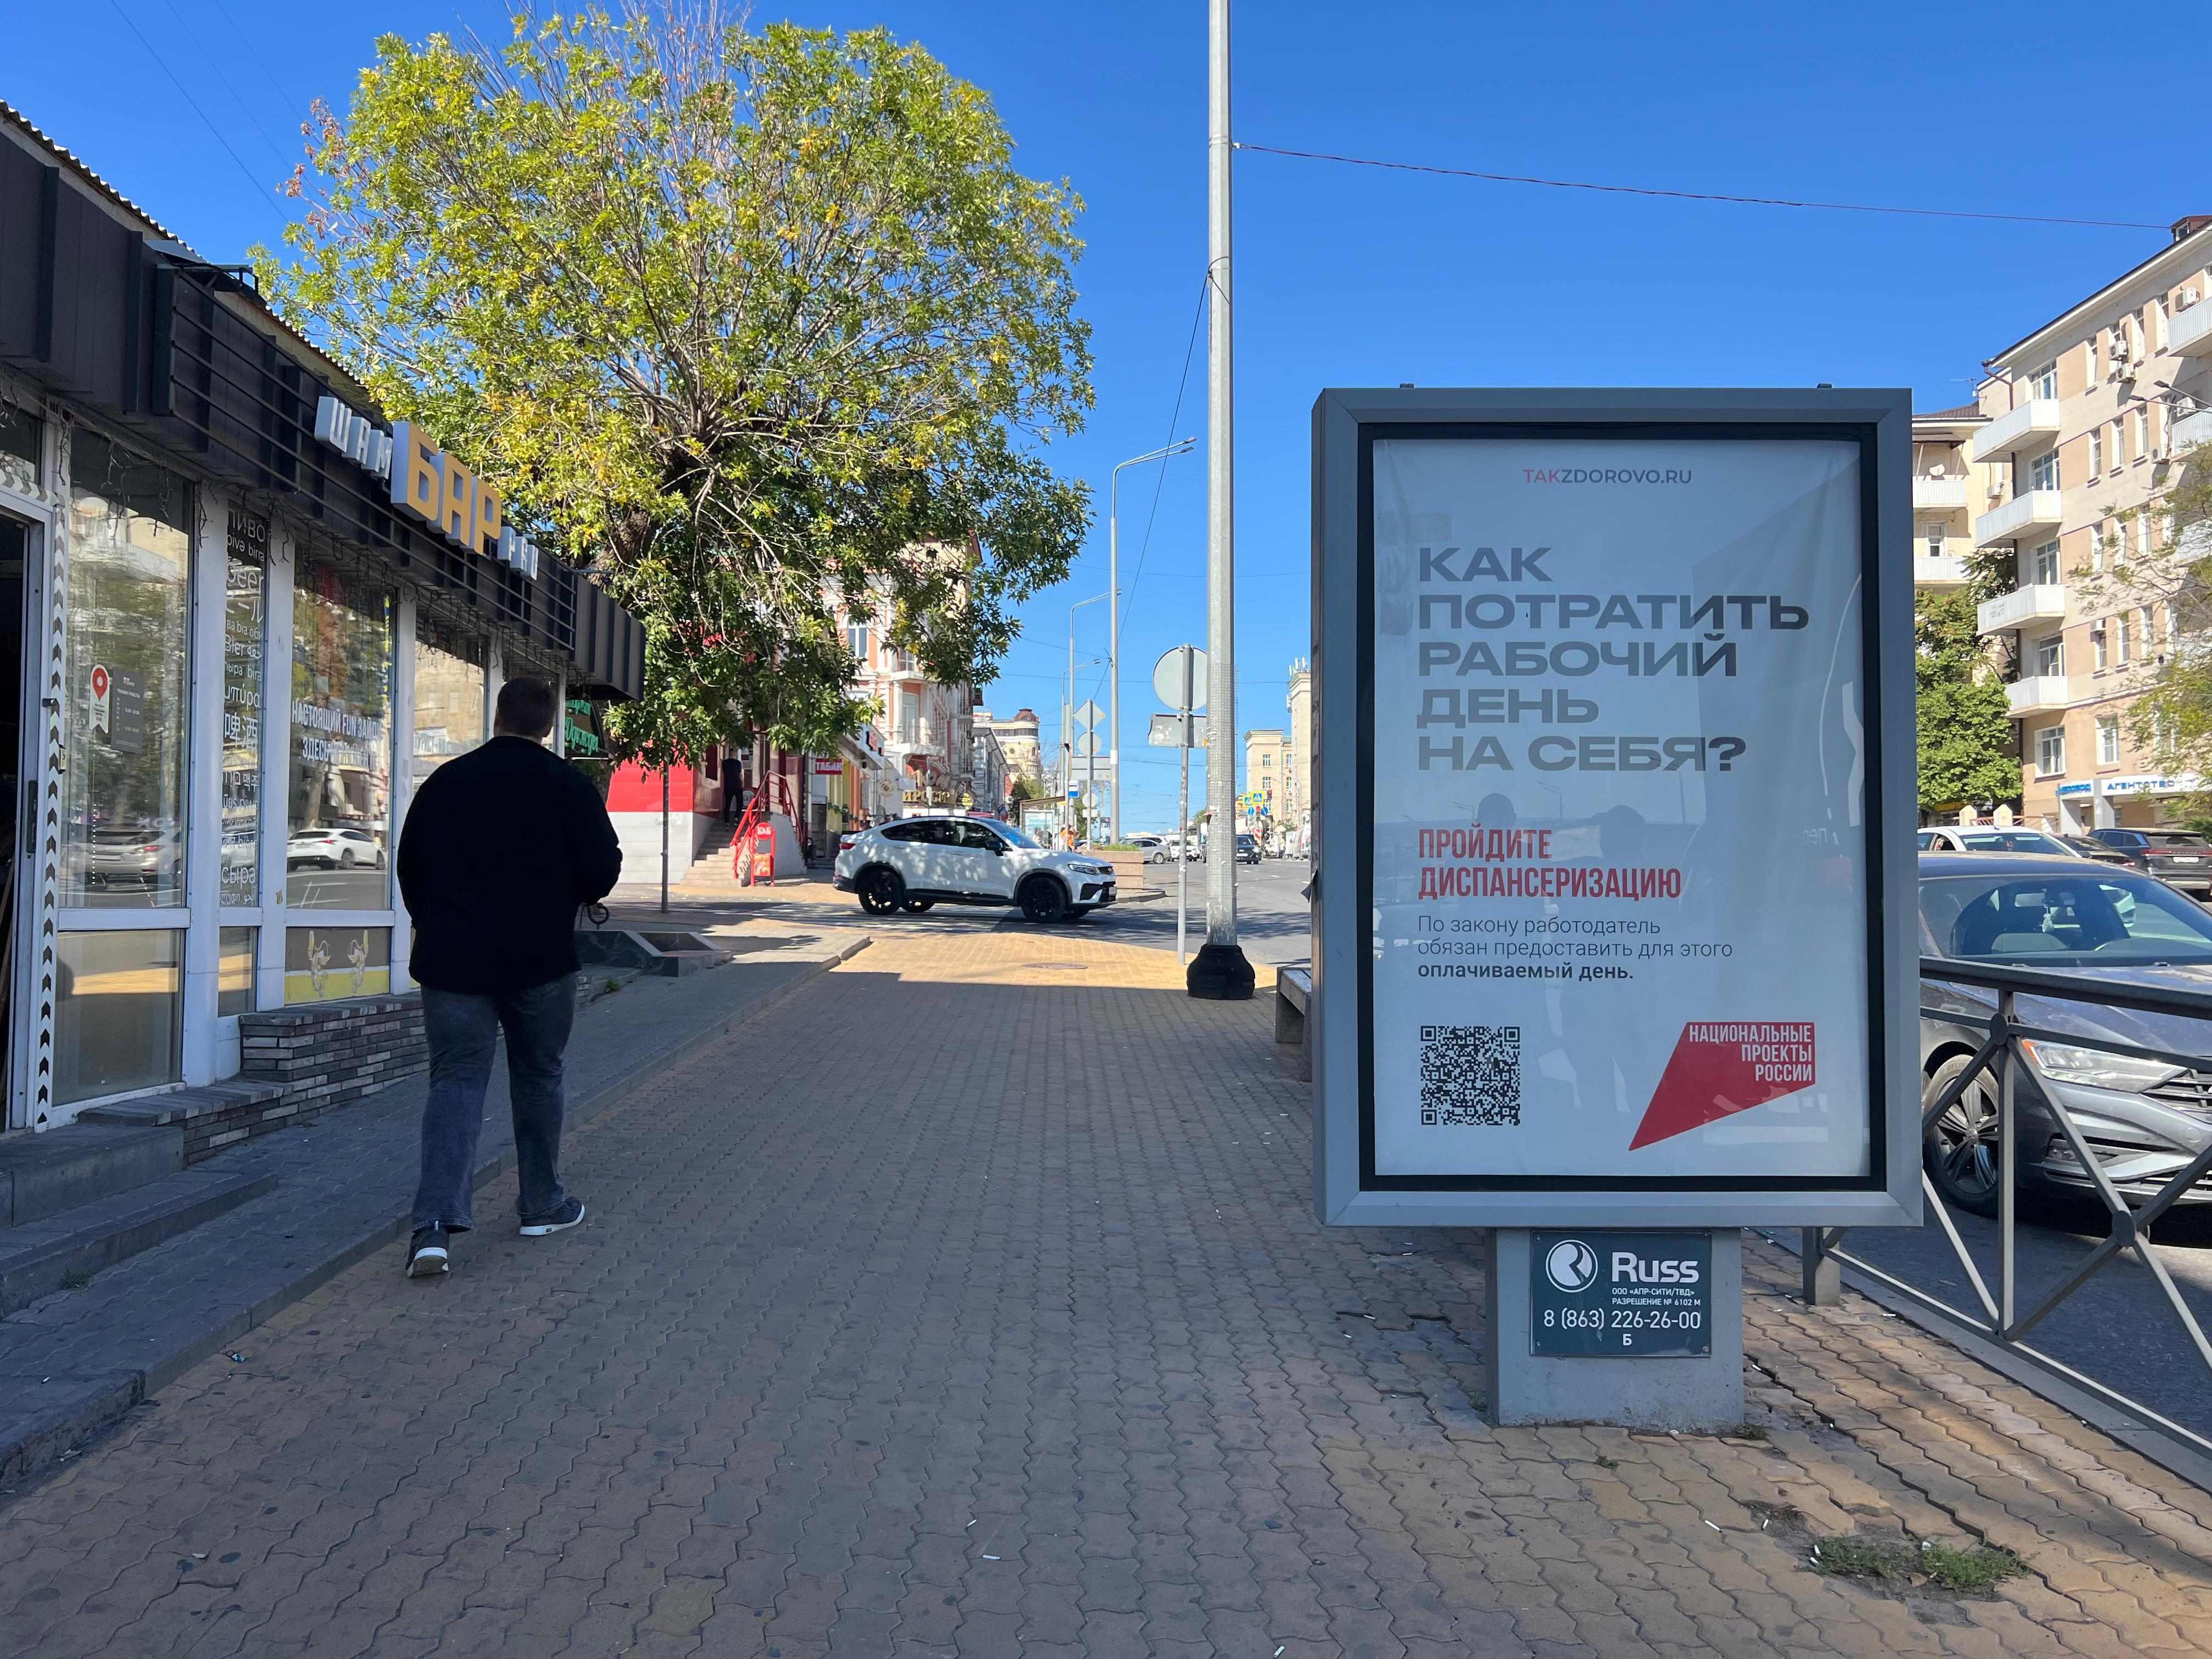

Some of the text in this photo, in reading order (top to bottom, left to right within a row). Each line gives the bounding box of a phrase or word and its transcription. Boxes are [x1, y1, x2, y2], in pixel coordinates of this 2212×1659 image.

[315, 396, 393, 479] ШАМ
[392, 421, 501, 555] БАР
[1523, 469, 1692, 484] TAKZDOROVO.RU
[1419, 548, 1553, 582] КАК
[1419, 594, 1809, 630] ПОТРАТИТЬ
[1419, 633, 1737, 677] РАБОЧИЙ
[292, 700, 341, 733] НАСТОЯЩИЙ
[342, 714, 357, 737] FUN
[1417, 689, 1599, 729] ДЕНЬ
[302, 737, 329, 762] ЗДЕСЬ
[1418, 735, 1747, 772] НА СЕБЯ?
[1419, 823, 1552, 862] ПРОЙДИТЕ
[1418, 867, 1681, 901] ДИСПАНСЕРИЗАЦИЮ
[1418, 916, 1661, 936] По закону работодатель
[1418, 939, 1733, 960] обязан предоставить для этого
[1418, 962, 1634, 981] оплачиваемый день.
[1690, 1025, 1812, 1043] НАЦИОНАЛЬНЫЕ
[1741, 1044, 1812, 1062] ПРОЕКТЫ
[1755, 1064, 1812, 1081] РОССИИ
[1611, 1251, 1700, 1283] Russ
[1612, 1297, 1662, 1306] РАЗРЕШЕНИЕ
[1544, 1307, 1701, 1329] 8 (863) 226-26-00
[1622, 1334, 1632, 1346] Б
